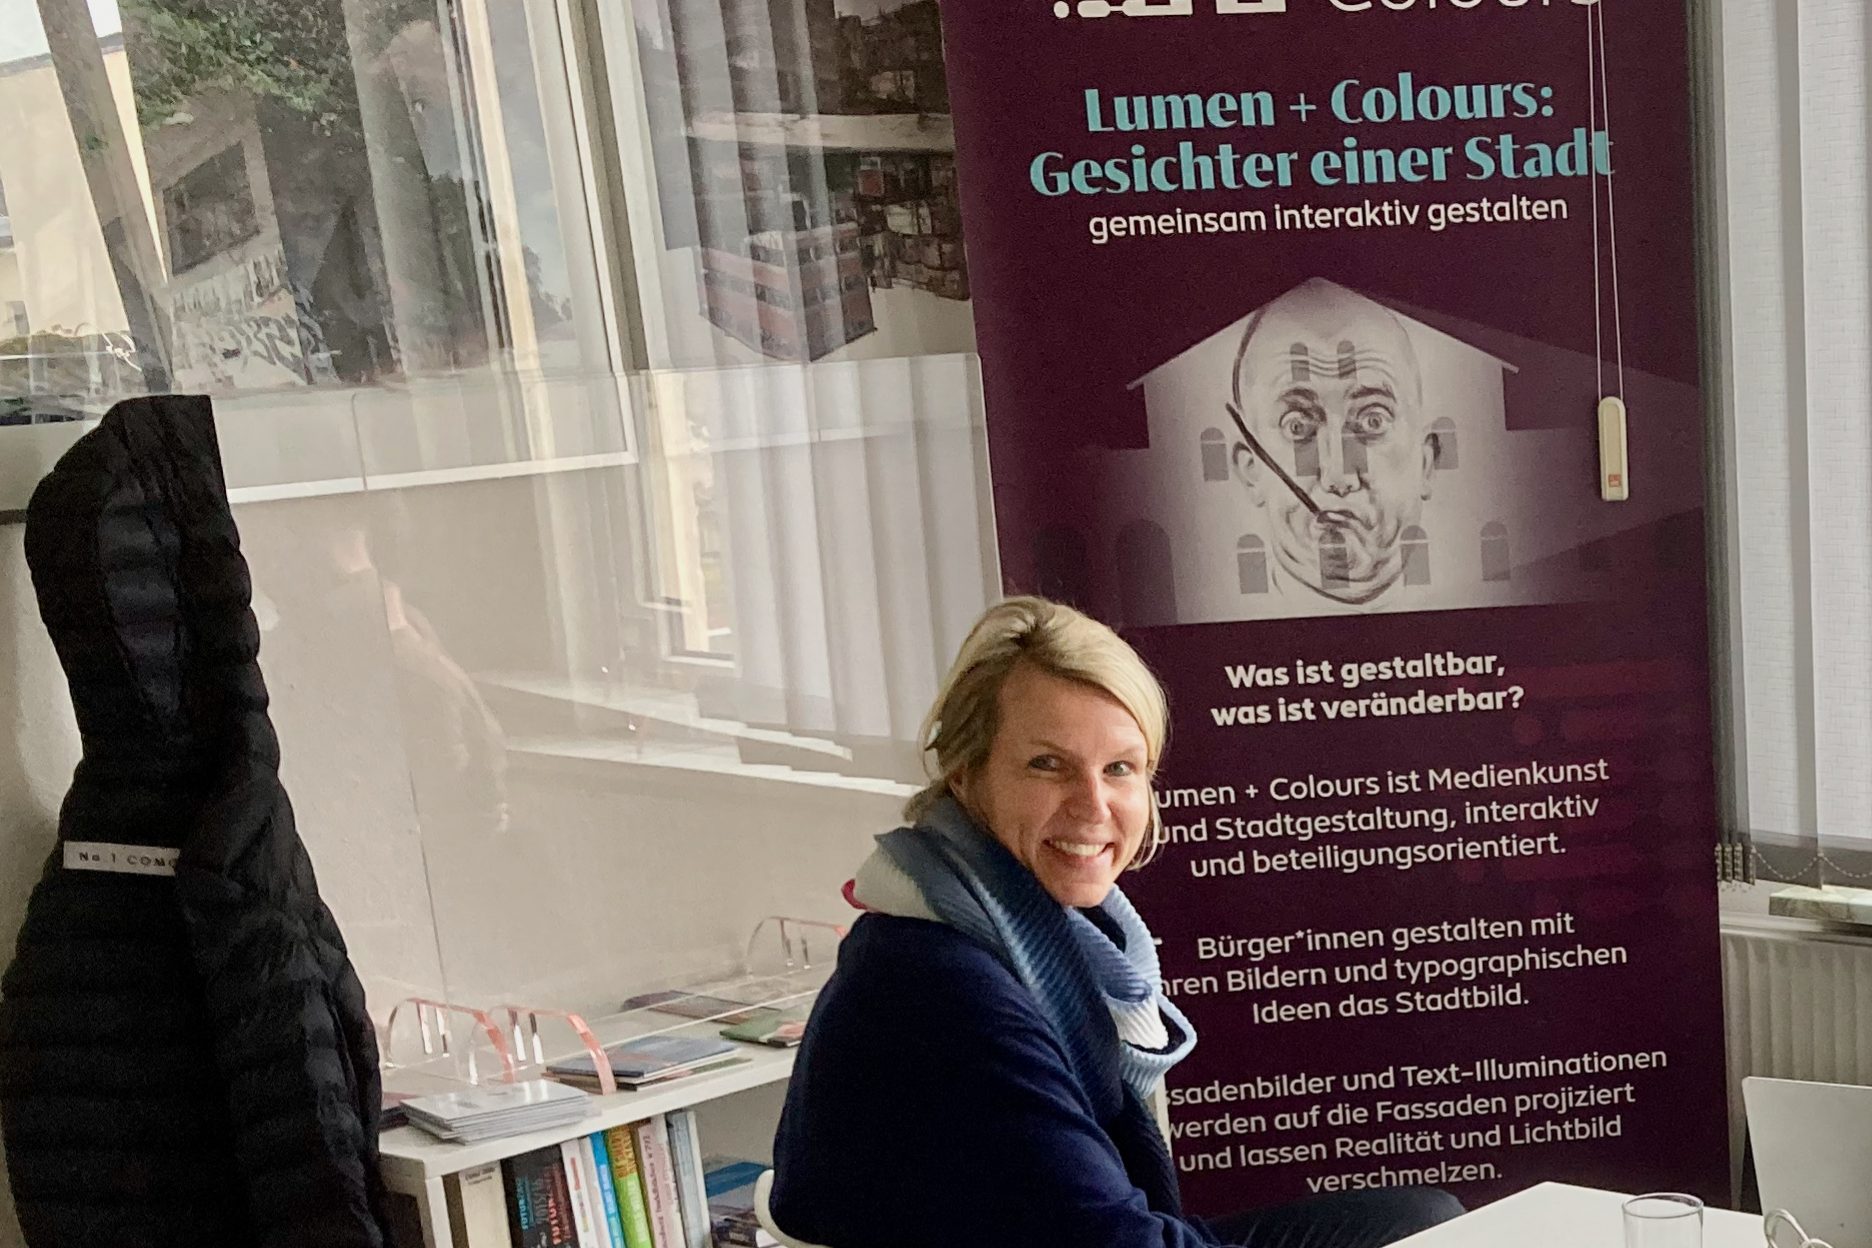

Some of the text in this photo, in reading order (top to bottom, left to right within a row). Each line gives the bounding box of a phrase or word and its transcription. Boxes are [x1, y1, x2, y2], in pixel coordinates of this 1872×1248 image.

[1085, 73, 1553, 131] Lumen + Colours:
[1031, 128, 1614, 195] Gesichter einer Stadt
[1090, 194, 1567, 244] gemeinsam interaktiv gestalten
[1225, 652, 1504, 688] Was ist gestaltbar,
[1211, 686, 1524, 725] was ist veränderbar?
[1155, 759, 1609, 808] umen + Colours ist Medienkunst
[1216, 807, 1455, 840] Stadtgestaltung,
[1466, 795, 1598, 823] interaktiv
[1191, 833, 1565, 877] und beteiligungsorientiert.
[1392, 918, 1522, 951] gestalten
[1531, 913, 1574, 935] mit
[1162, 945, 1626, 996] ren Bildern und typographischen
[1253, 983, 1528, 1023] Ideen das Stadtbild.
[1166, 1051, 1666, 1106] sadenbilder und Text-Illuminationen
[1275, 1105, 1320, 1130] auf
[1327, 1103, 1368, 1125] die
[1377, 1094, 1506, 1121] Fassaden
[1515, 1083, 1635, 1121] projiziert
[1180, 1115, 1621, 1171] und lassen Realität und Lichtbild
[1307, 1162, 1502, 1192] verschmelzen.
